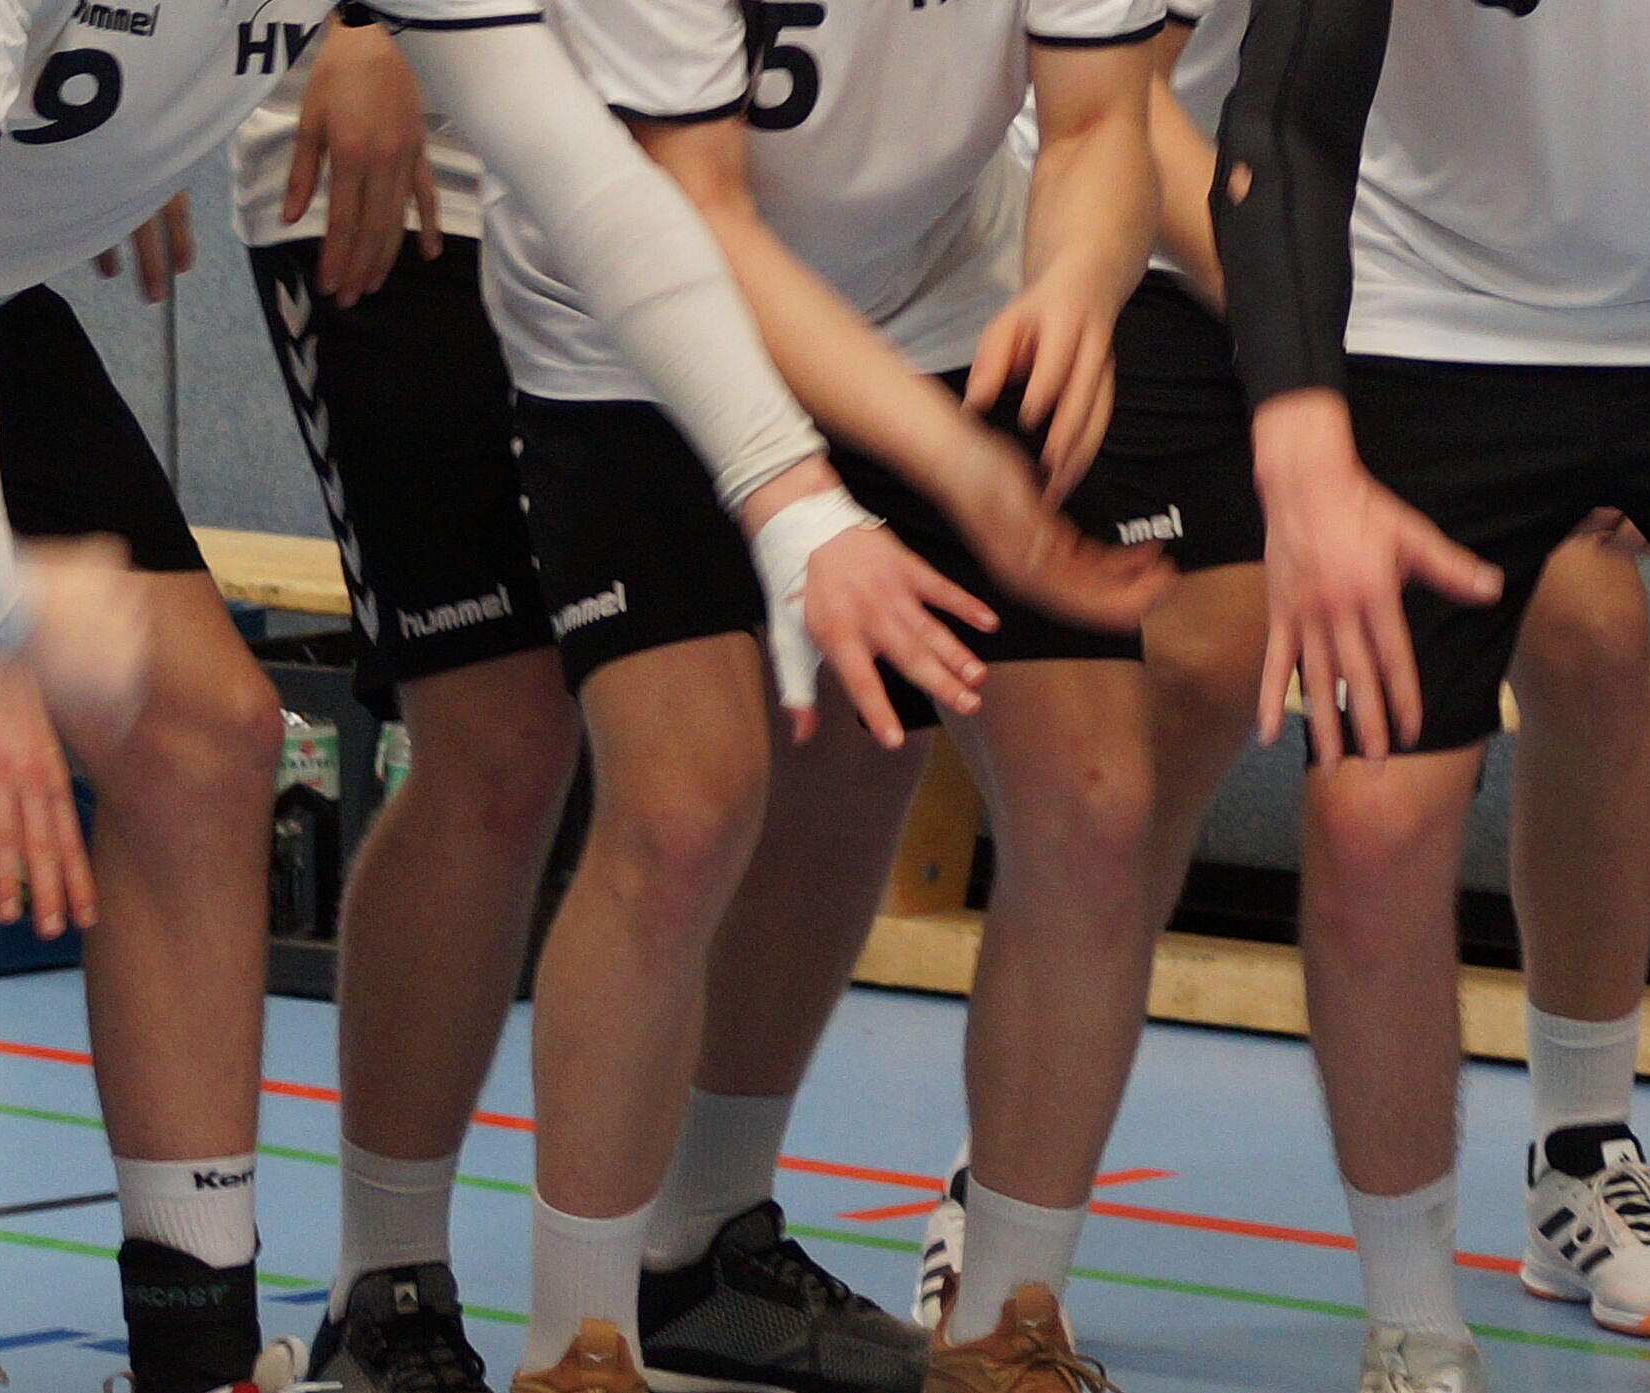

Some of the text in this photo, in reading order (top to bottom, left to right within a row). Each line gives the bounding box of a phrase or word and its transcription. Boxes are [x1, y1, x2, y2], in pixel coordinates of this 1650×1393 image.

[235, 21, 324, 76] HV
[9, 47, 123, 145] 9
[1115, 503, 1184, 546] mel
[398, 581, 514, 640] hummel
